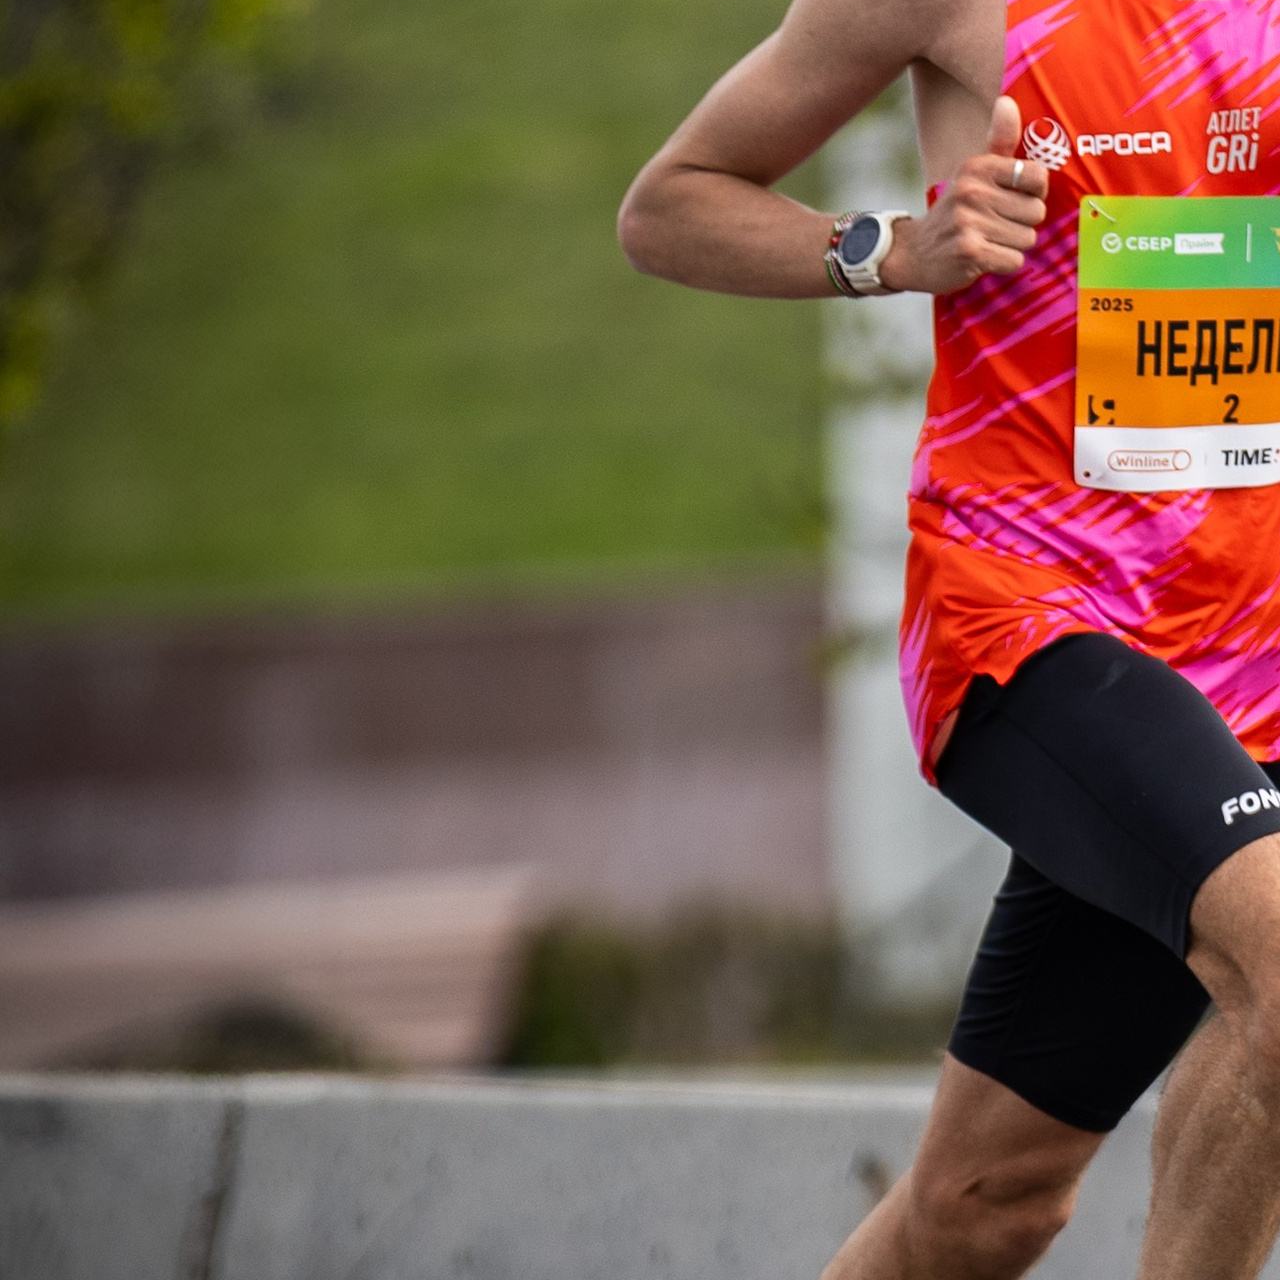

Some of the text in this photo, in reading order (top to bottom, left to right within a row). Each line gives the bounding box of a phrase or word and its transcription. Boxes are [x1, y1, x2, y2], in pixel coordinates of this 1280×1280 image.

[1206, 106, 1262, 135] АТЛЕТ
[1125, 235, 1173, 251] СБЕР
[1090, 298, 1134, 312] 2025
[1223, 394, 1240, 423] 2
[1116, 455, 1169, 467] Winline
